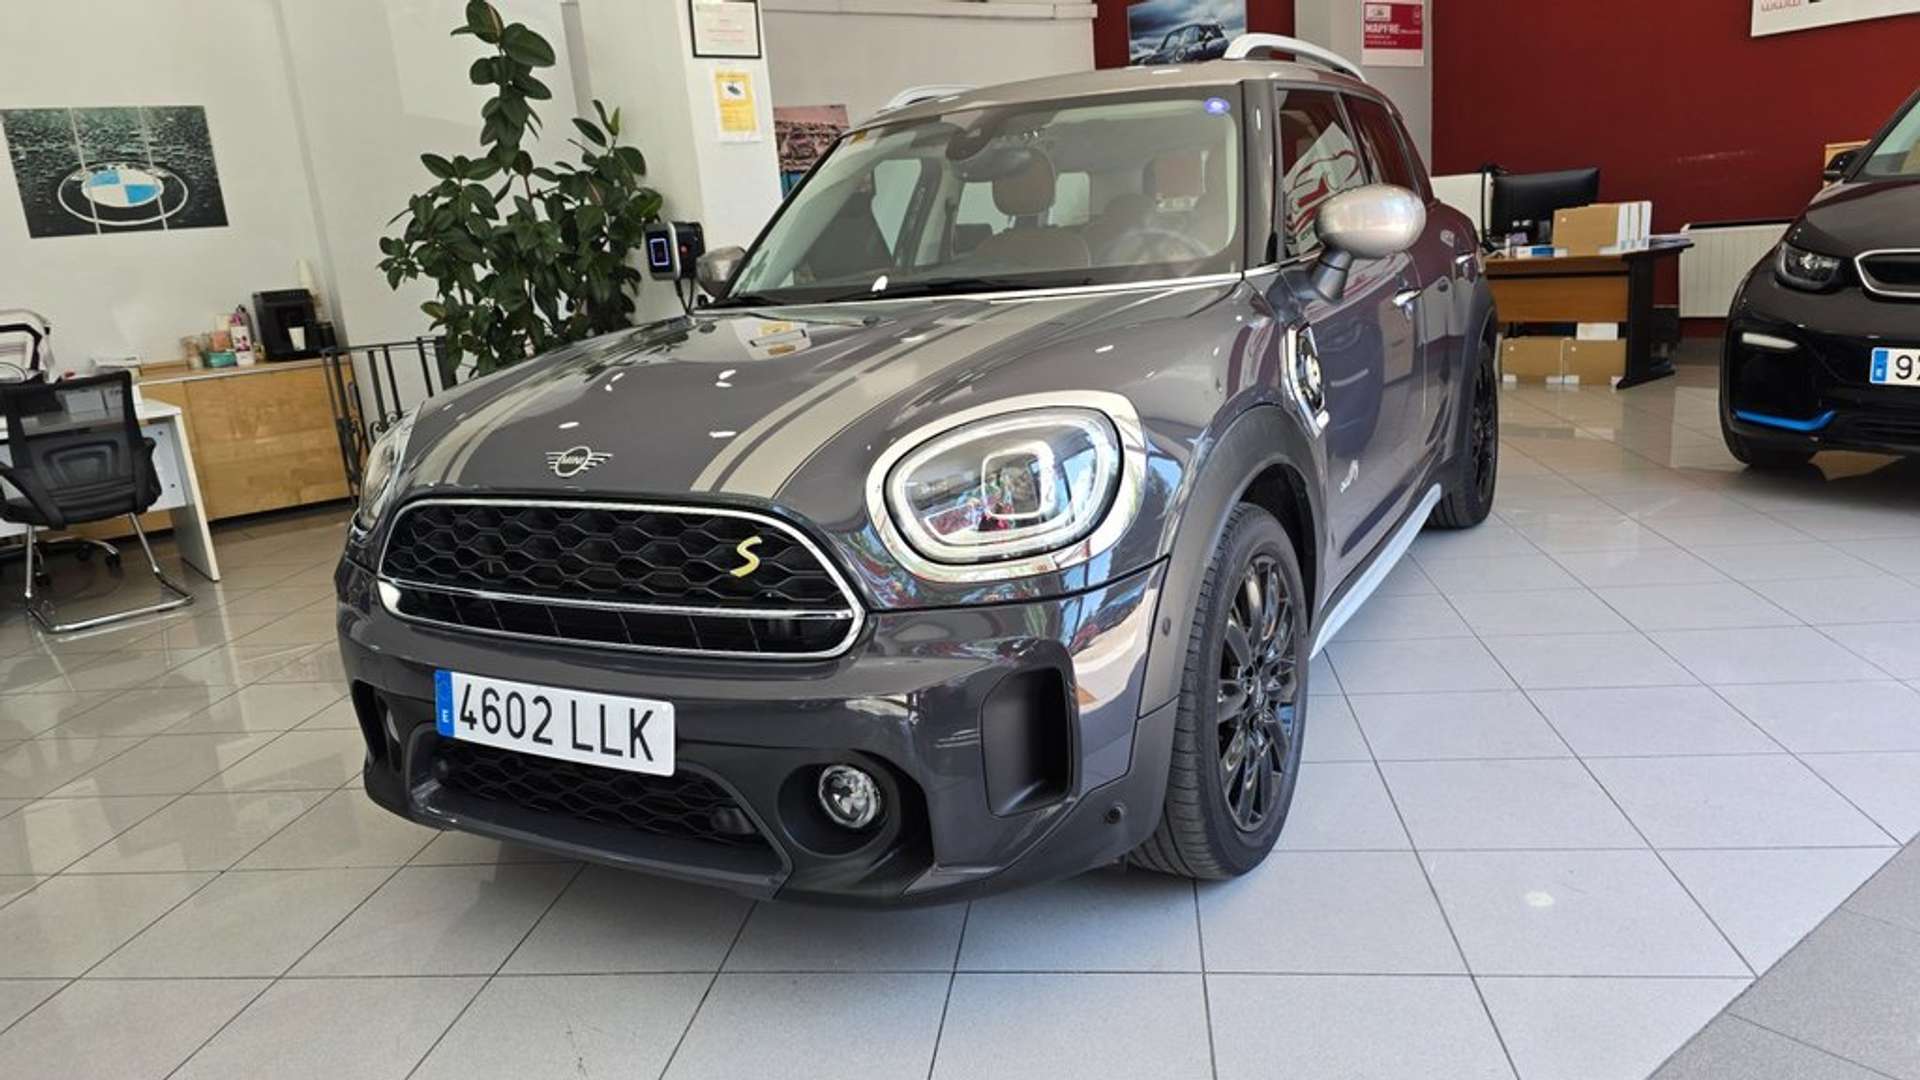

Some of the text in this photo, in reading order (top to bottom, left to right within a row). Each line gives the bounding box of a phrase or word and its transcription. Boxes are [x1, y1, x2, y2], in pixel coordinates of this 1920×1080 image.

[1896, 354, 1920, 380] 9
[560, 456, 586, 464] MINI
[730, 536, 762, 577] S
[460, 683, 654, 762] 4602 LLK
